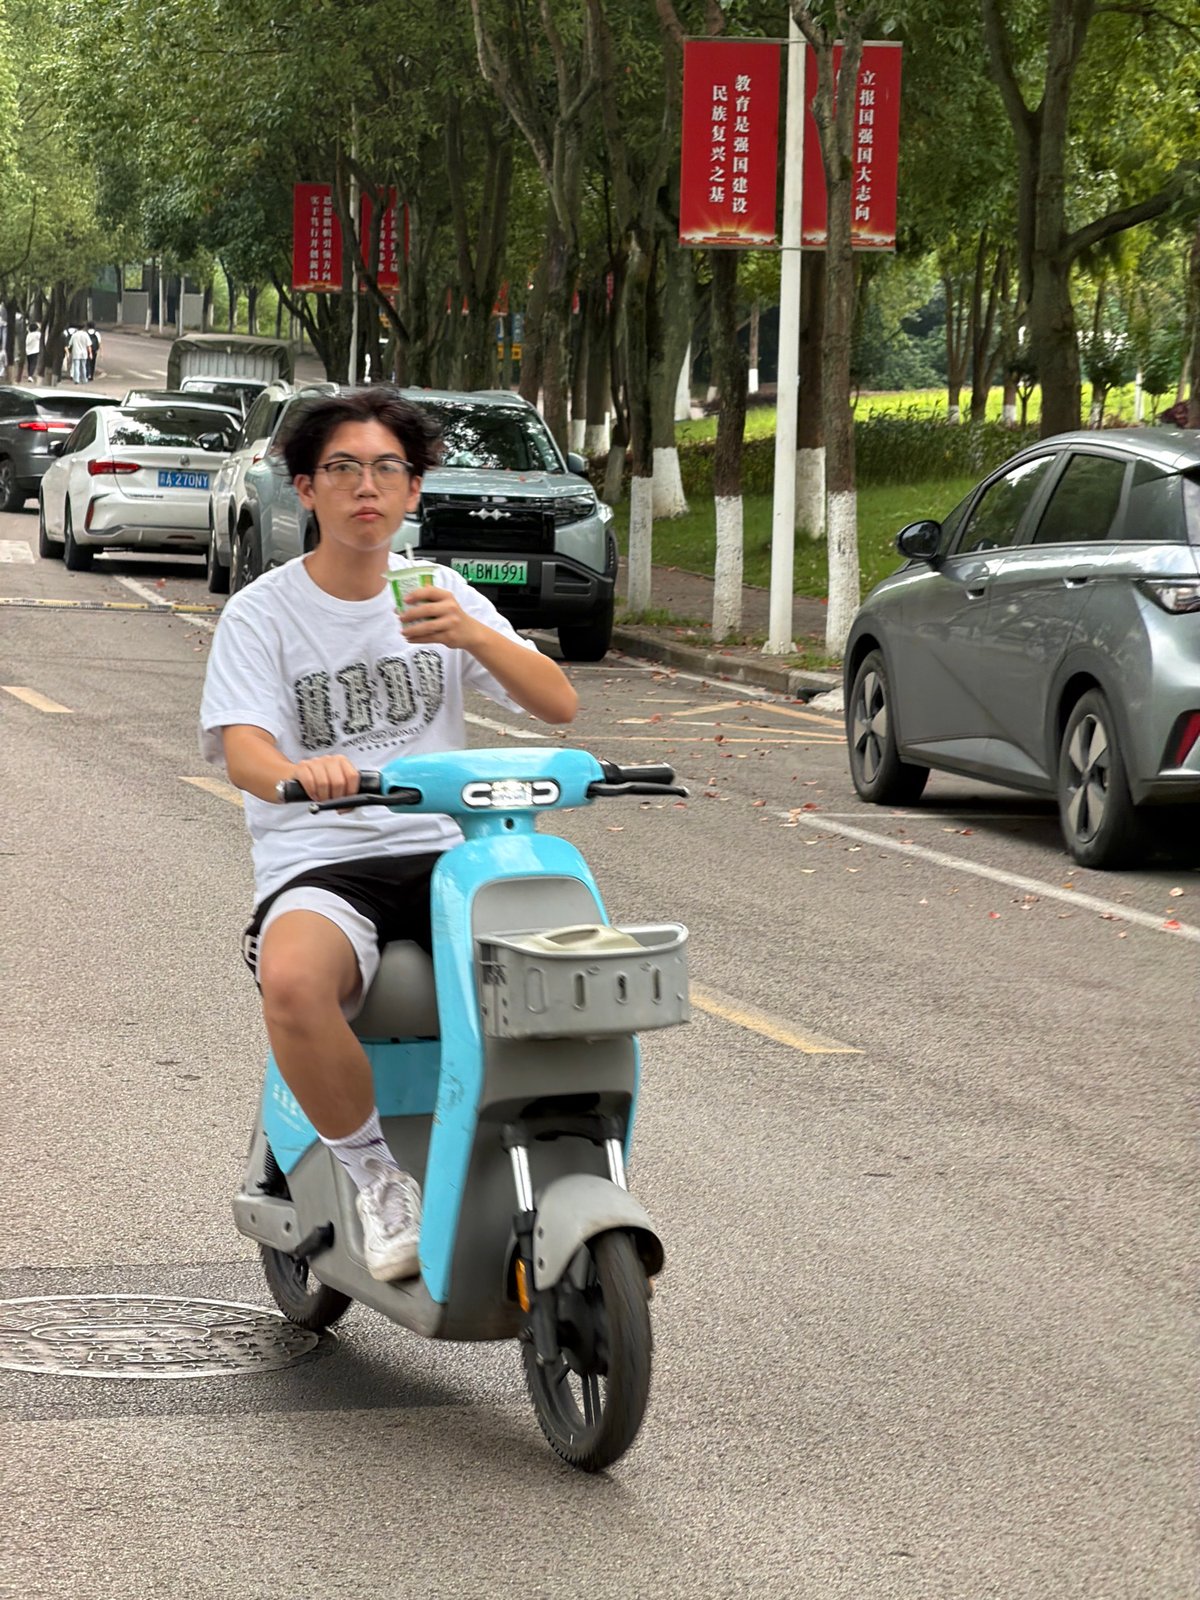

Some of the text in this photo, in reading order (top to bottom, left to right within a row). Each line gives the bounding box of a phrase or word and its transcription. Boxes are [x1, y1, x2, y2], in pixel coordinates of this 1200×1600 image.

[708, 85, 728, 203] 民族复兴之基
[732, 74, 751, 214] 教育是强国建设
[855, 70, 876, 221] 立报国强国大志向
